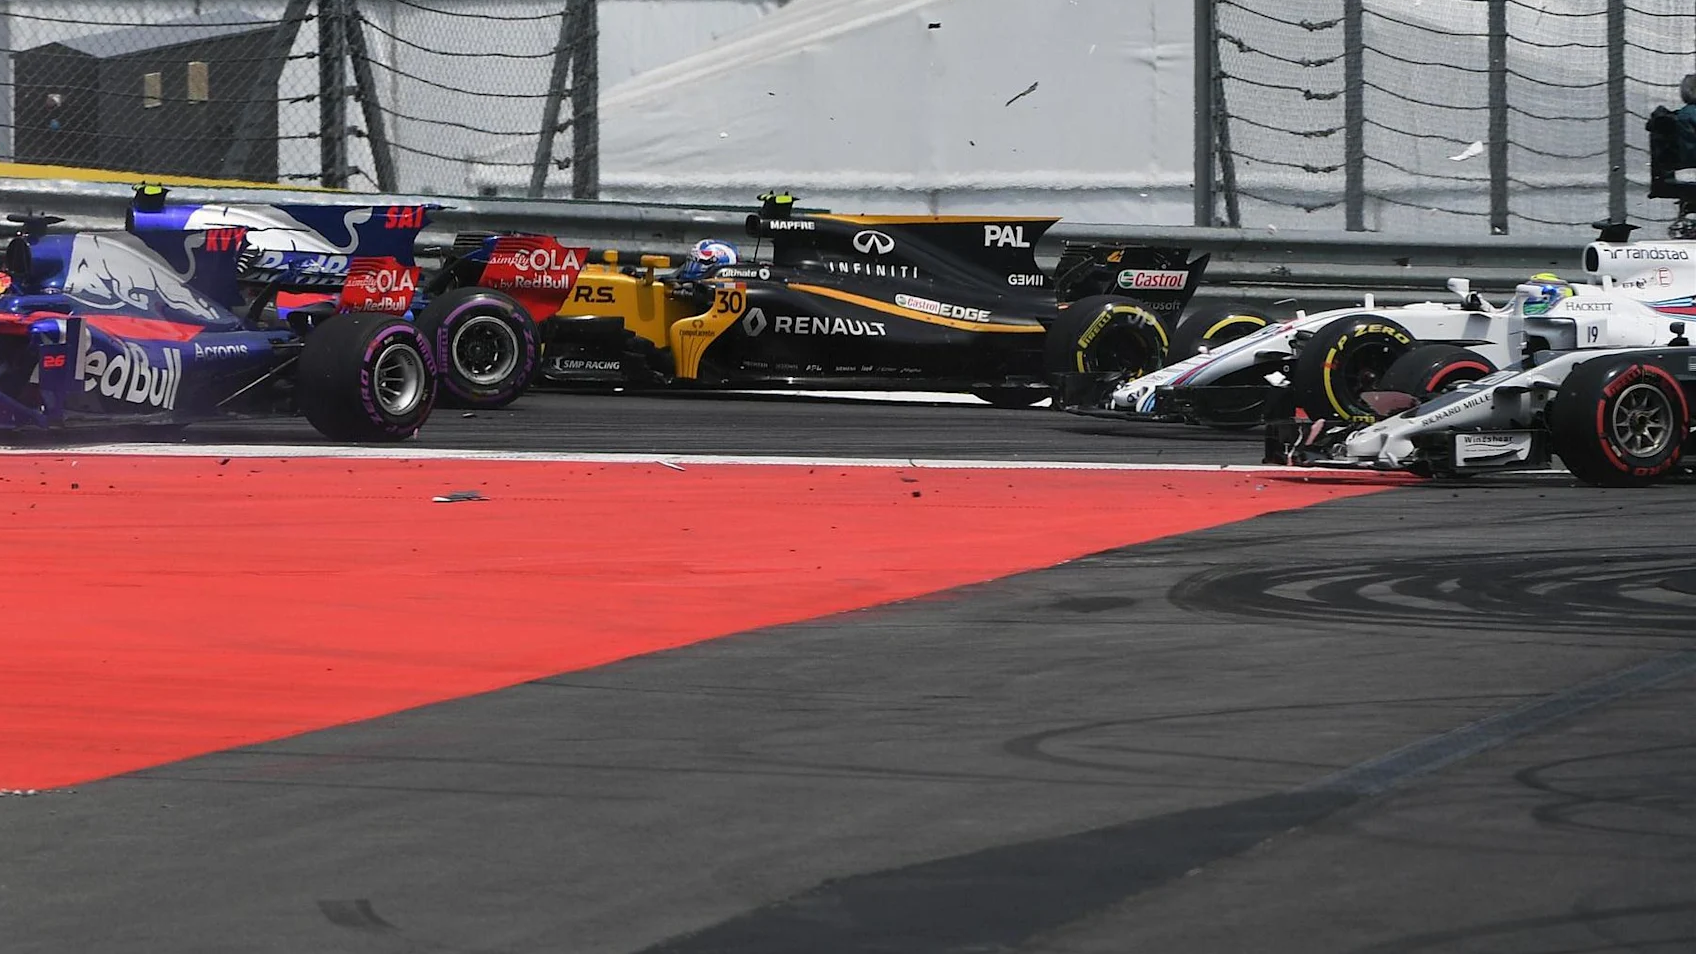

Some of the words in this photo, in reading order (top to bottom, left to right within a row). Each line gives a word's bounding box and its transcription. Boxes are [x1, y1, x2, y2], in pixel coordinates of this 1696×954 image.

[384, 205, 425, 229] SAI
[770, 220, 815, 231] MAPFRE
[205, 227, 247, 252] KVY
[983, 225, 1031, 248] PAL
[488, 254, 531, 268] simply
[514, 248, 581, 271] COLA
[1626, 247, 1689, 261] randstad
[829, 261, 919, 279] INFINITI
[1135, 272, 1184, 288] Castrol
[364, 269, 417, 294] COLA
[573, 285, 616, 303] R.S.
[716, 290, 743, 314] 30
[906, 297, 939, 314] Castrol
[939, 304, 992, 323] EDGE
[1565, 301, 1613, 312] HACKETT
[774, 315, 887, 337] RENAULT
[1354, 324, 1411, 345] ZERO
[1587, 325, 1599, 344] 19
[194, 342, 248, 359] Acronis
[43, 354, 66, 371] 26
[563, 359, 585, 369] SMP
[585, 360, 620, 371] RACING
[1421, 405, 1462, 427] RICHARD
[1463, 393, 1493, 412] MILLE
